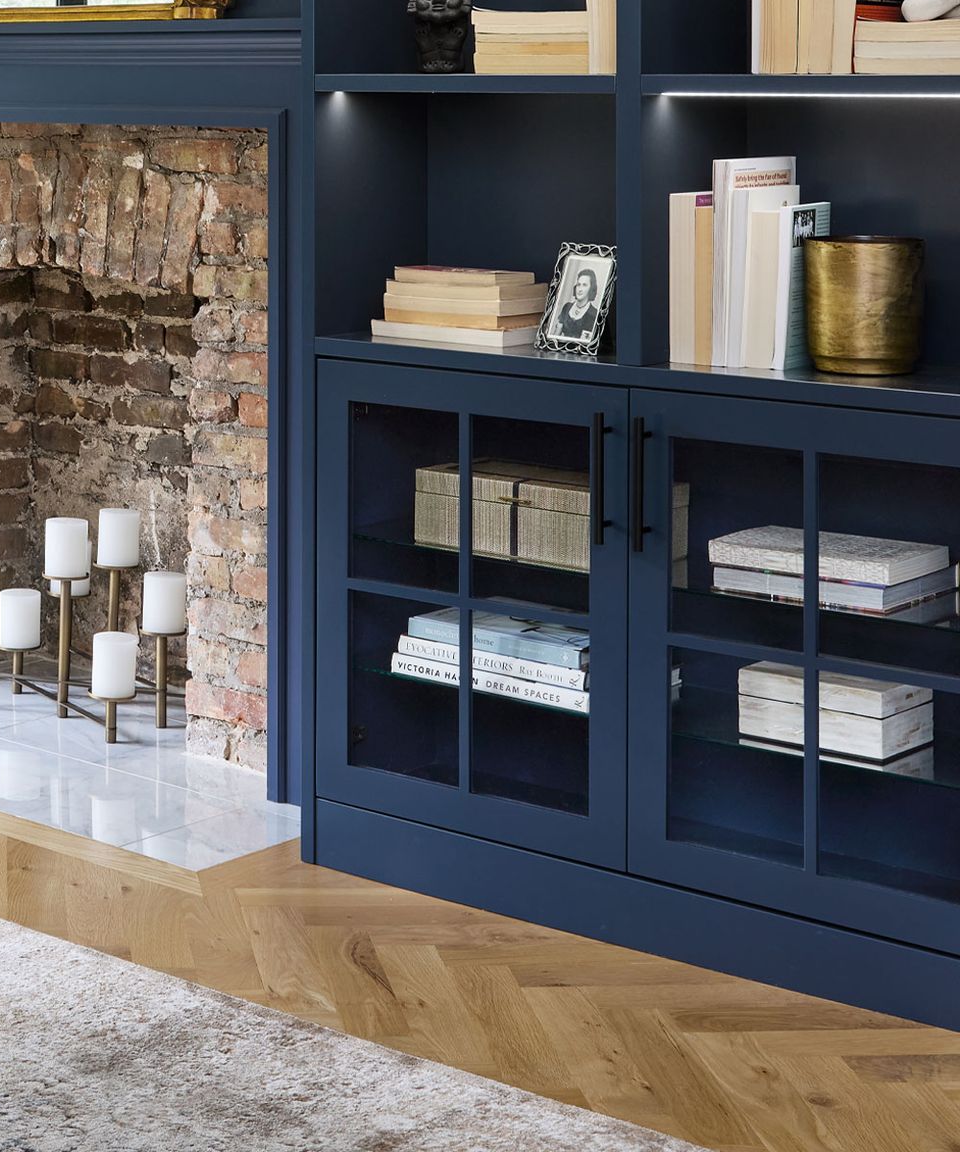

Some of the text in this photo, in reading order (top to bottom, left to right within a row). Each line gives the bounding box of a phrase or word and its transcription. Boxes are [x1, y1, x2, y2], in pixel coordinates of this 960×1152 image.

[397, 661, 562, 703] VICTORIA HAN DREAM SPACES
